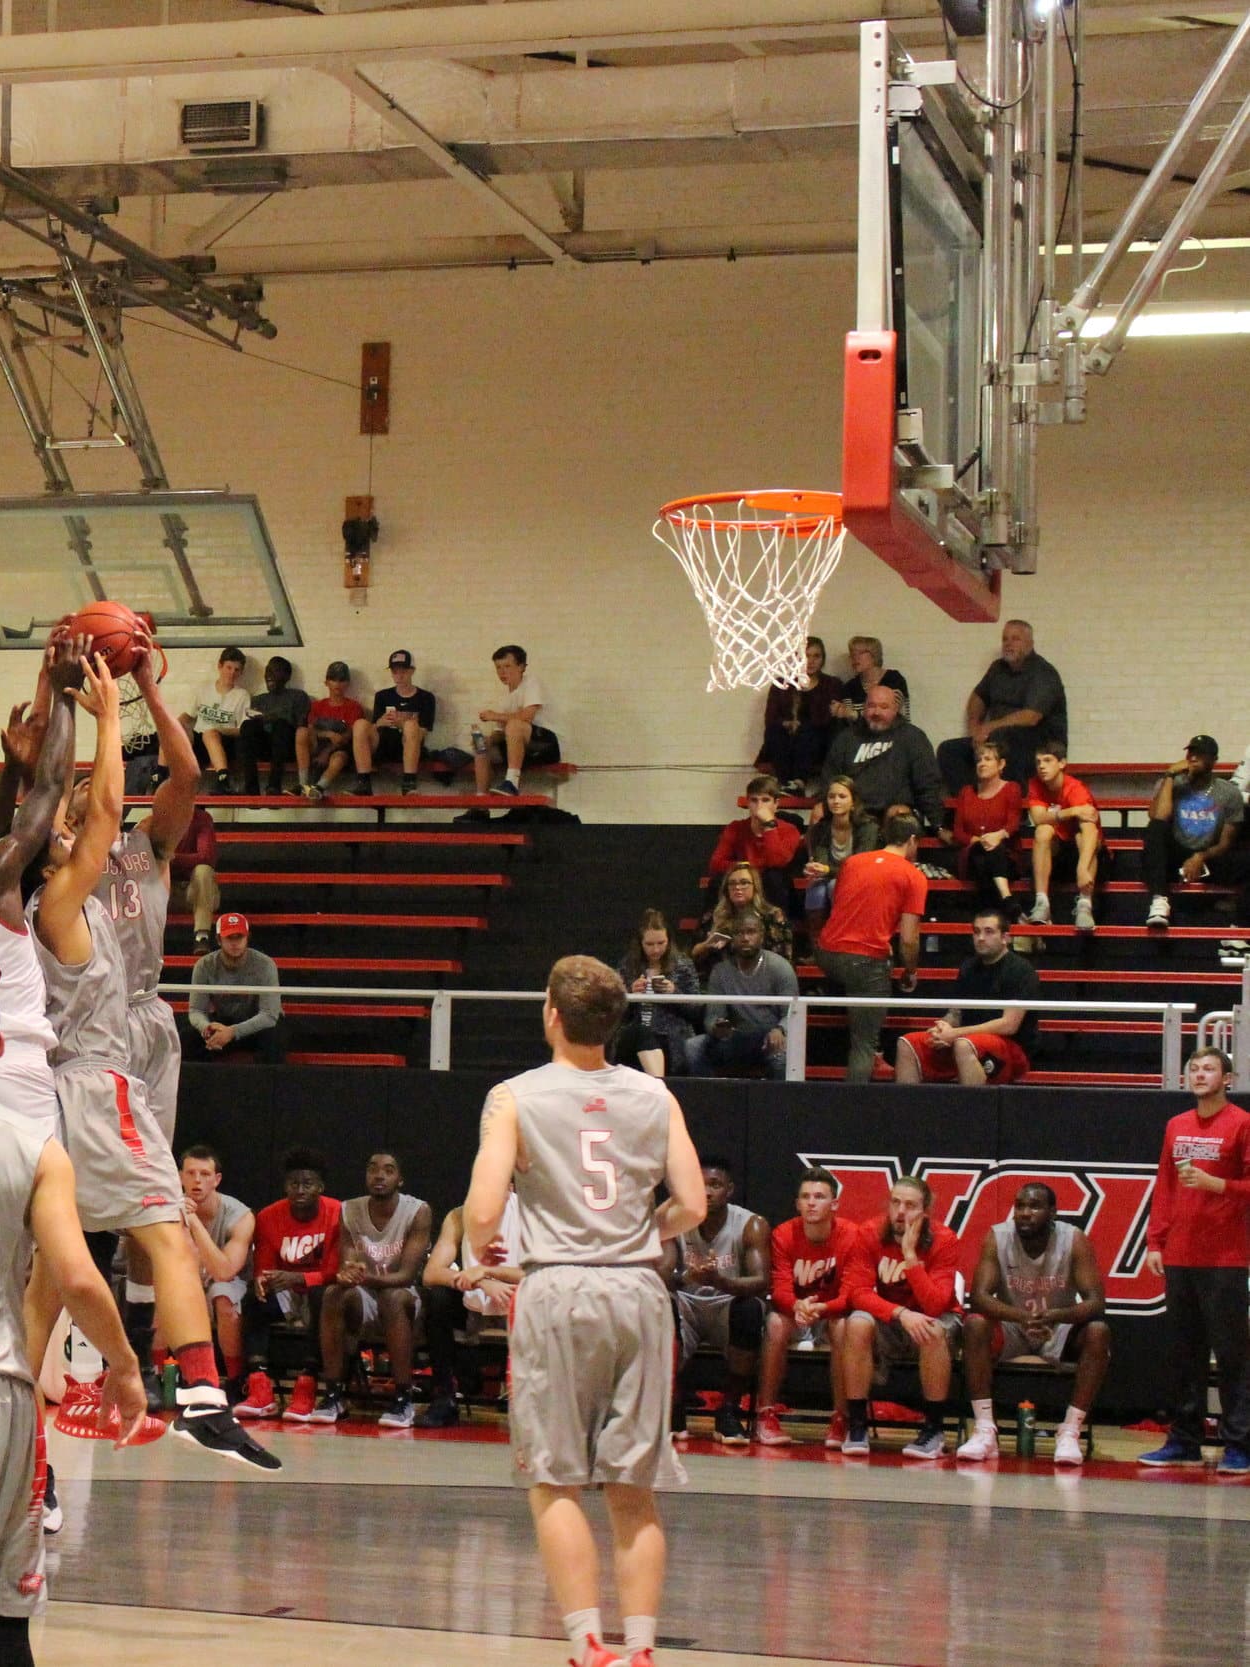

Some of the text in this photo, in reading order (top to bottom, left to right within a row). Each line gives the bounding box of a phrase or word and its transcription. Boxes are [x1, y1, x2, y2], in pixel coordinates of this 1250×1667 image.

[1180, 809, 1215, 821] NASA
[110, 879, 142, 920] 13
[579, 1129, 618, 1211] 5
